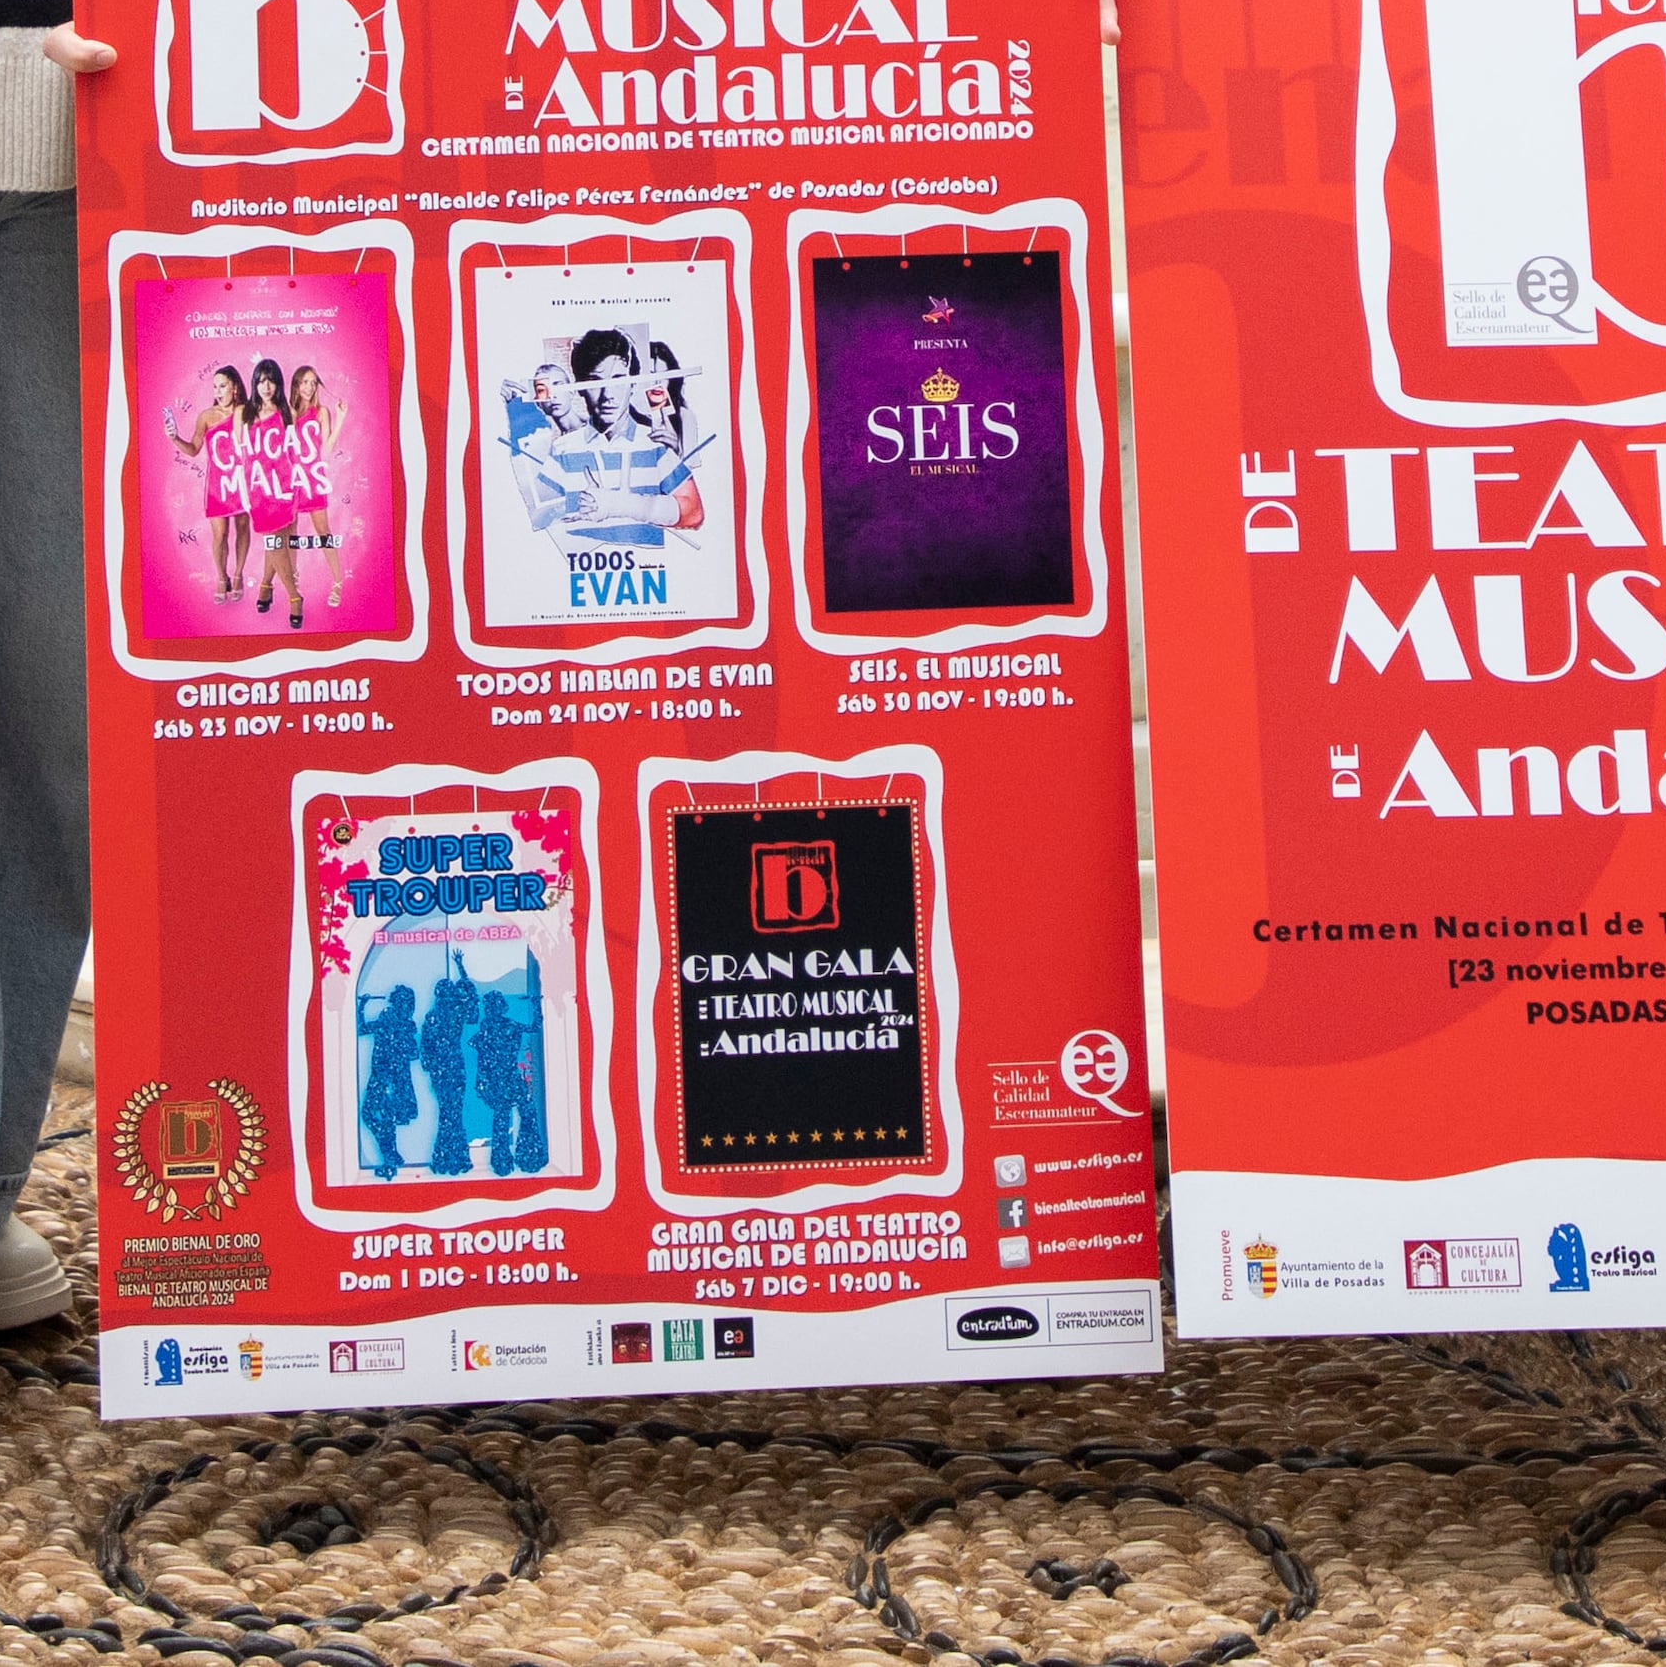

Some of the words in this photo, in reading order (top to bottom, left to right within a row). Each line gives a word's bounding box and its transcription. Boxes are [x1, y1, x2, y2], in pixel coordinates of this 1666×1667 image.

[533, 43, 1002, 129] Andalucía
[1007, 39, 1033, 117] 2024
[504, 76, 523, 111] DE
[421, 134, 540, 157] CERTAMEN
[547, 131, 659, 154] NACIONAL
[665, 130, 694, 150] DE
[699, 127, 784, 149] TEATRO
[790, 124, 885, 146] MUSICAL
[890, 120, 1034, 142] AFICIONADO
[191, 198, 287, 218] Auditorio
[293, 194, 398, 218] Municipal
[506, 189, 569, 213] Felipe
[575, 186, 634, 205] Pérez
[768, 181, 795, 200] de
[801, 179, 885, 199] Posadas
[890, 176, 999, 199] (Córdoba)
[1452, 289, 1486, 303] Sello
[1490, 289, 1506, 303] de
[1454, 305, 1507, 319] Calidad
[1456, 321, 1552, 334] Escenamateur
[913, 338, 969, 351] PRESENTA
[210, 420, 321, 471] CHICAS
[867, 401, 1020, 464] SEIS
[928, 463, 979, 476] MUSICAL
[220, 460, 333, 511] MALAS
[1240, 449, 1301, 554] DE
[567, 551, 635, 572] TODOS
[570, 570, 667, 608] EVAN
[457, 672, 551, 697] TODOS
[561, 669, 657, 693] HABLAN
[666, 667, 700, 689] DE
[708, 663, 773, 687] EVAN
[849, 659, 908, 683] SEIS.
[916, 657, 941, 680] EL
[948, 653, 1062, 678] MUSICAL
[176, 682, 280, 708] CHICAS
[288, 678, 370, 703] MALAS
[837, 693, 877, 713] Sáb
[884, 692, 911, 712] 30
[916, 690, 964, 710] NOV
[983, 688, 1046, 707] 19:00
[1052, 687, 1074, 705] h.
[491, 706, 542, 726] Dom
[549, 705, 577, 724] 24
[583, 702, 630, 723] NOV
[650, 699, 713, 720] 18:00
[720, 698, 742, 718] h.
[154, 719, 193, 740] Sáb
[199, 718, 226, 737] 23
[235, 716, 282, 737] NOV
[302, 713, 366, 733] 19:00
[371, 712, 394, 731] h.
[1331, 743, 1362, 799] DE
[379, 833, 514, 875] SUPER
[347, 873, 547, 918] TROUPER
[393, 928, 450, 944] musical
[456, 927, 474, 942] de
[478, 925, 523, 941] ABBA
[1253, 920, 1418, 942] Certamen
[1435, 913, 1588, 939] Nacional
[1604, 911, 1643, 936] de
[683, 951, 793, 983] GRAN
[804, 947, 915, 979] GALA
[1448, 958, 1495, 989] [23
[1506, 955, 1666, 983] noviembre
[711, 992, 797, 1020] TEATRO
[801, 988, 899, 1016] MUSICAL
[881, 1014, 914, 1026] 2024
[711, 1023, 899, 1056] Andalucía
[993, 1070, 1029, 1086] Sello
[1032, 1070, 1050, 1085] de
[993, 1087, 1051, 1104] Calidad
[994, 1104, 1098, 1121] Escenamateur
[1034, 1152, 1143, 1173] www.esfiga.es
[1034, 1190, 1145, 1215] bienalteatromusical
[652, 1220, 724, 1246] GRAN
[733, 1217, 795, 1242] GALA
[804, 1215, 851, 1239] DEL
[857, 1210, 961, 1237] TEATRO
[124, 1237, 169, 1253] PREMIO
[172, 1235, 212, 1251] BIENAL
[216, 1234, 231, 1249] DE
[233, 1233, 261, 1248] ORO
[352, 1233, 433, 1260] SUPER
[439, 1228, 565, 1256] TROUPER
[647, 1244, 763, 1272] MUSICAL
[771, 1243, 806, 1266] DE
[814, 1234, 967, 1265] ANDALUCÍA
[1037, 1232, 1143, 1254] info@esfiga.es
[1451, 1242, 1515, 1259] CONCEJALÍA
[1221, 1229, 1234, 1301] Promueve
[1281, 1259, 1356, 1274] Ayuntamiento
[1590, 1245, 1656, 1269] esfiga
[340, 1272, 391, 1292] Dom
[401, 1269, 409, 1288] 1
[419, 1267, 464, 1288] DIC
[486, 1264, 549, 1285] 18:00
[556, 1262, 578, 1282] h.
[695, 1279, 736, 1299] Sáb
[742, 1277, 754, 1296] 7
[763, 1275, 808, 1296] DIC
[829, 1272, 892, 1293] 19:00
[899, 1271, 921, 1290] h.
[1281, 1276, 1310, 1289] Villa
[1314, 1276, 1330, 1288] de
[1334, 1275, 1385, 1288] Posadas
[1461, 1269, 1508, 1283] CULTURA
[1622, 1268, 1657, 1276] Musical
[119, 1284, 152, 1296] BIENAL
[171, 1281, 207, 1294] TEATRO
[209, 1279, 251, 1292] MUSICAL
[152, 1292, 209, 1308] ANDALUCÍA
[211, 1293, 234, 1306] 2024
[670, 1319, 696, 1342] CATA
[962, 1315, 1033, 1333] entradium
[1056, 1317, 1145, 1330] ENTRADIUM.COM
[184, 1353, 228, 1369] esfiga
[495, 1343, 547, 1357] Diputación
[509, 1354, 548, 1366] Córdoba
